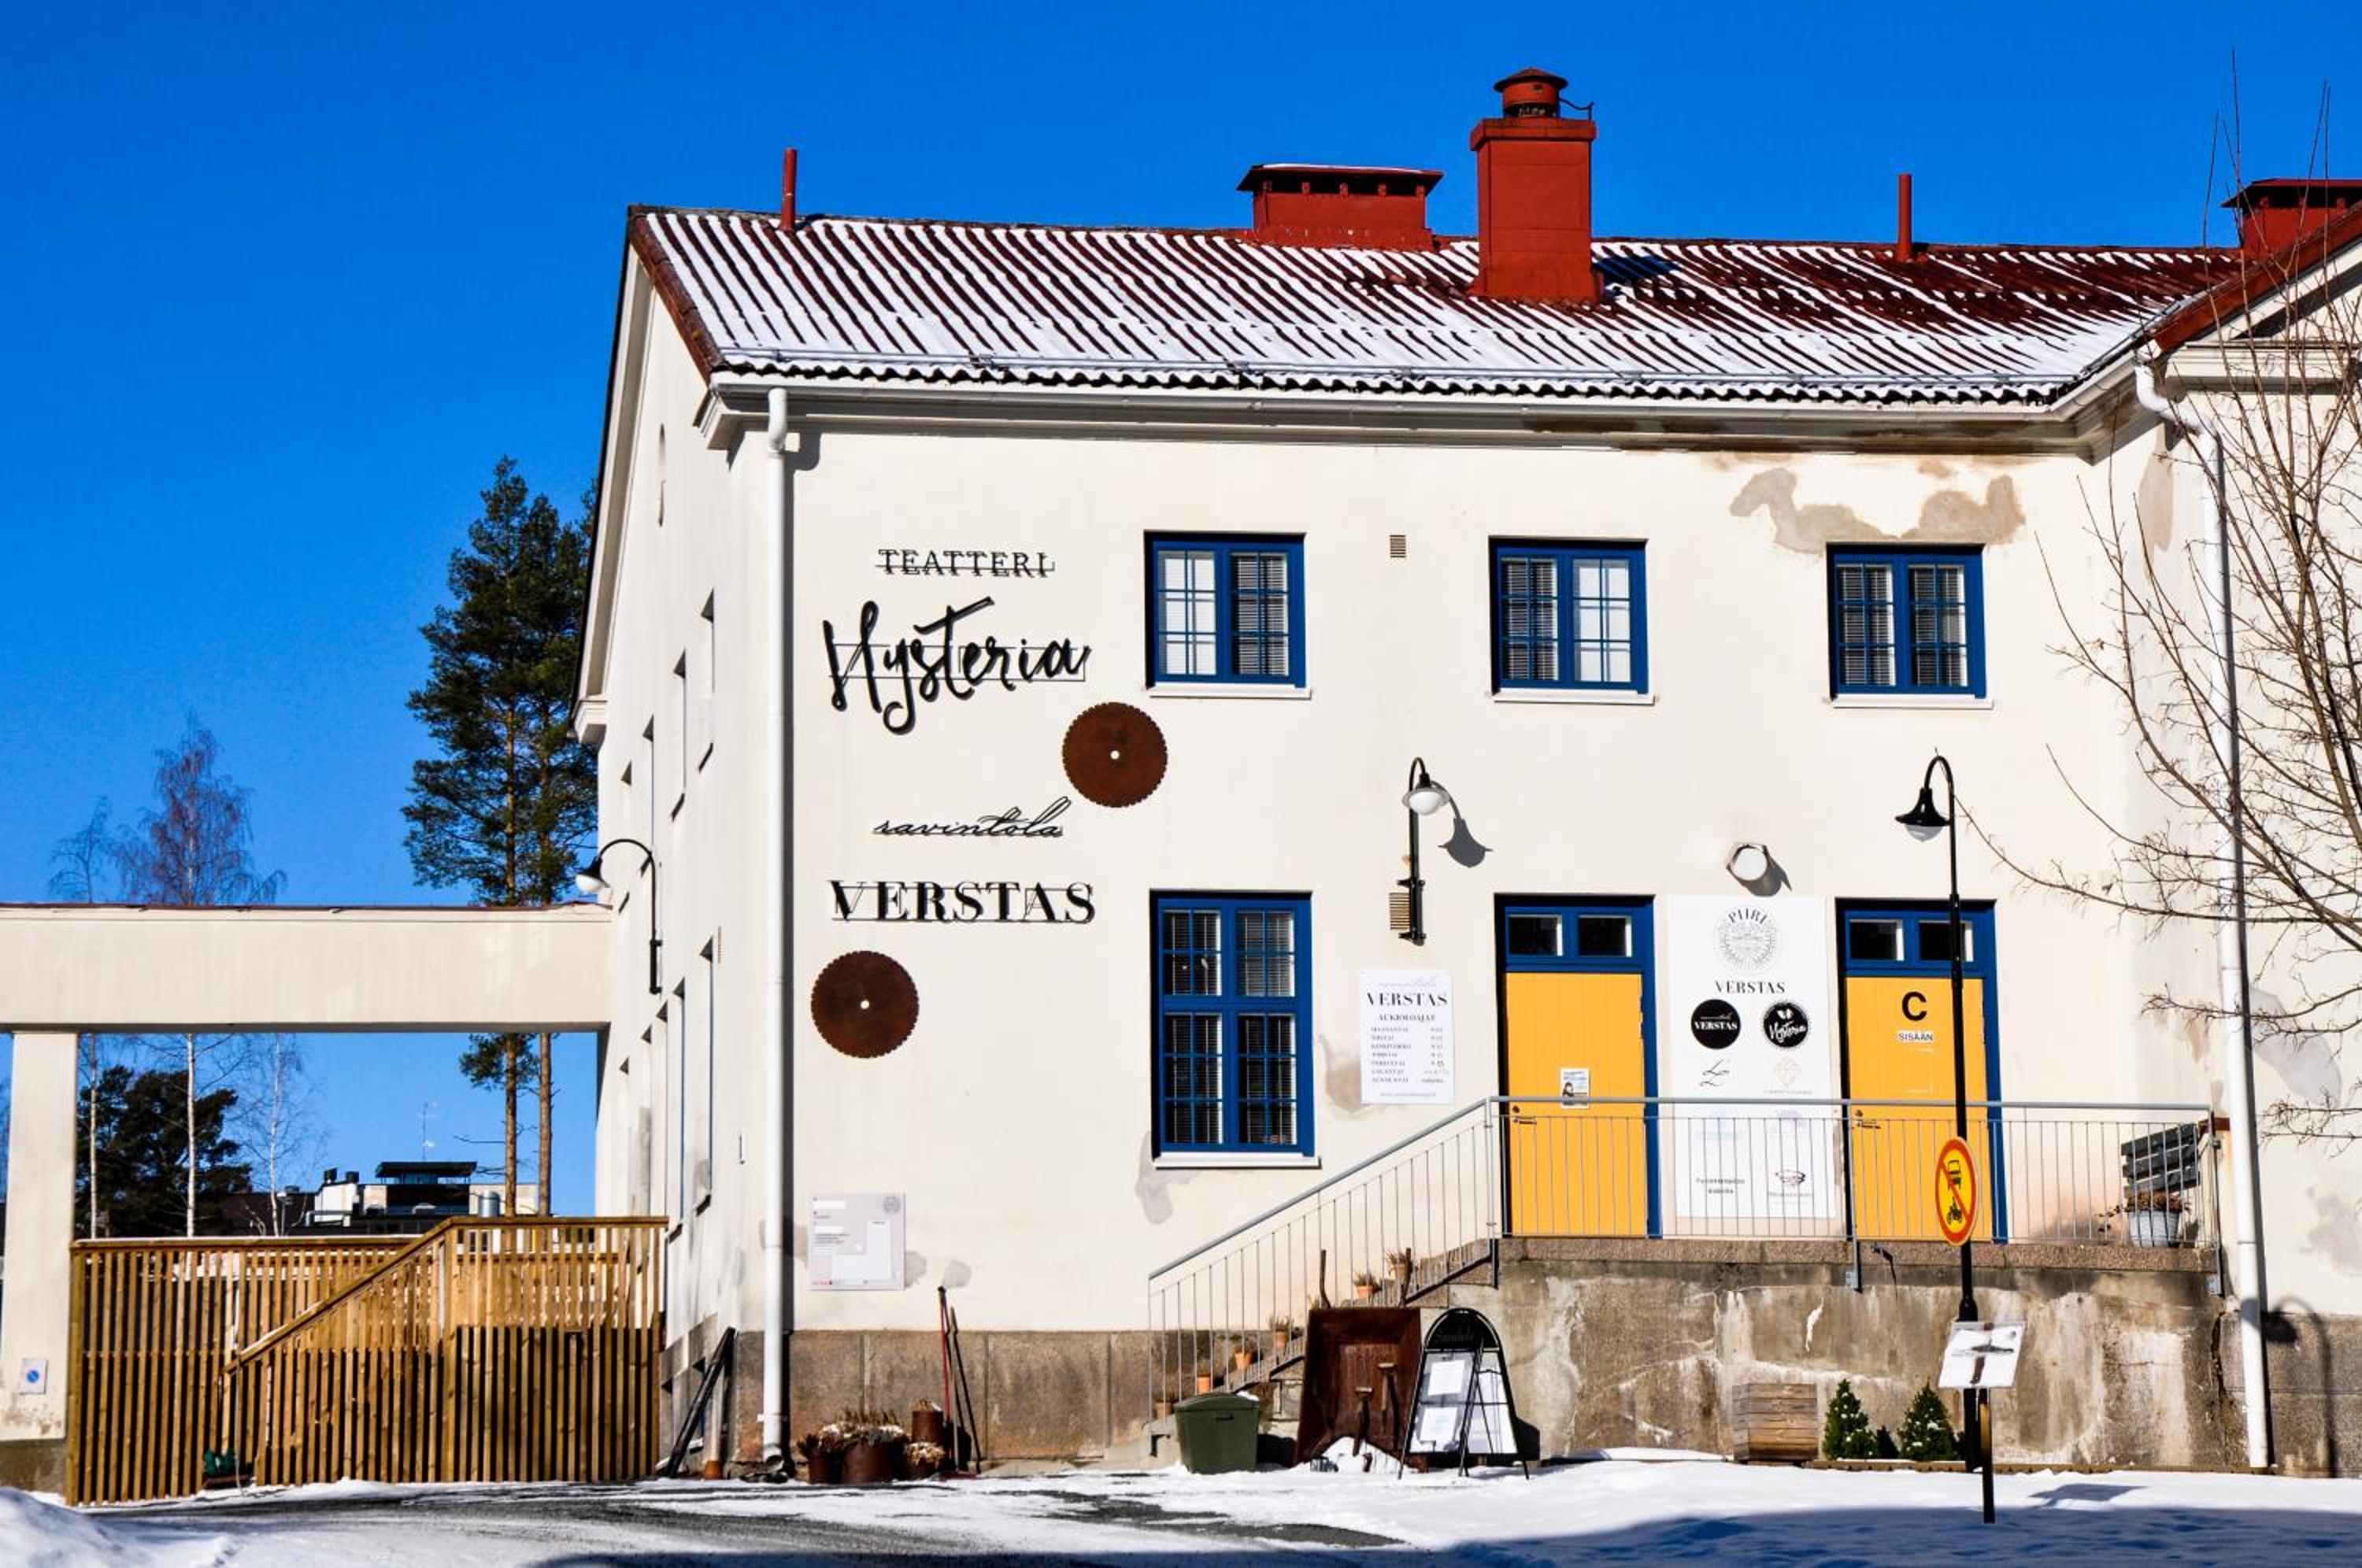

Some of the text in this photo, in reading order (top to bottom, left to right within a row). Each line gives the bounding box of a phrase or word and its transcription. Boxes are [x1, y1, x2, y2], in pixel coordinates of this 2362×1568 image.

[878, 549, 1051, 578] TEATTERI
[823, 596, 1091, 735] Hysteria
[872, 795, 1071, 837] ravintola
[828, 880, 1095, 924] VERSTAS
[1727, 908, 1768, 924] PIIRI
[1366, 992, 1448, 1007] VERSTAS
[1715, 981, 1786, 994] VERSTAS
[1901, 991, 1927, 1022] C
[1694, 1021, 1738, 1030] VERSTAS
